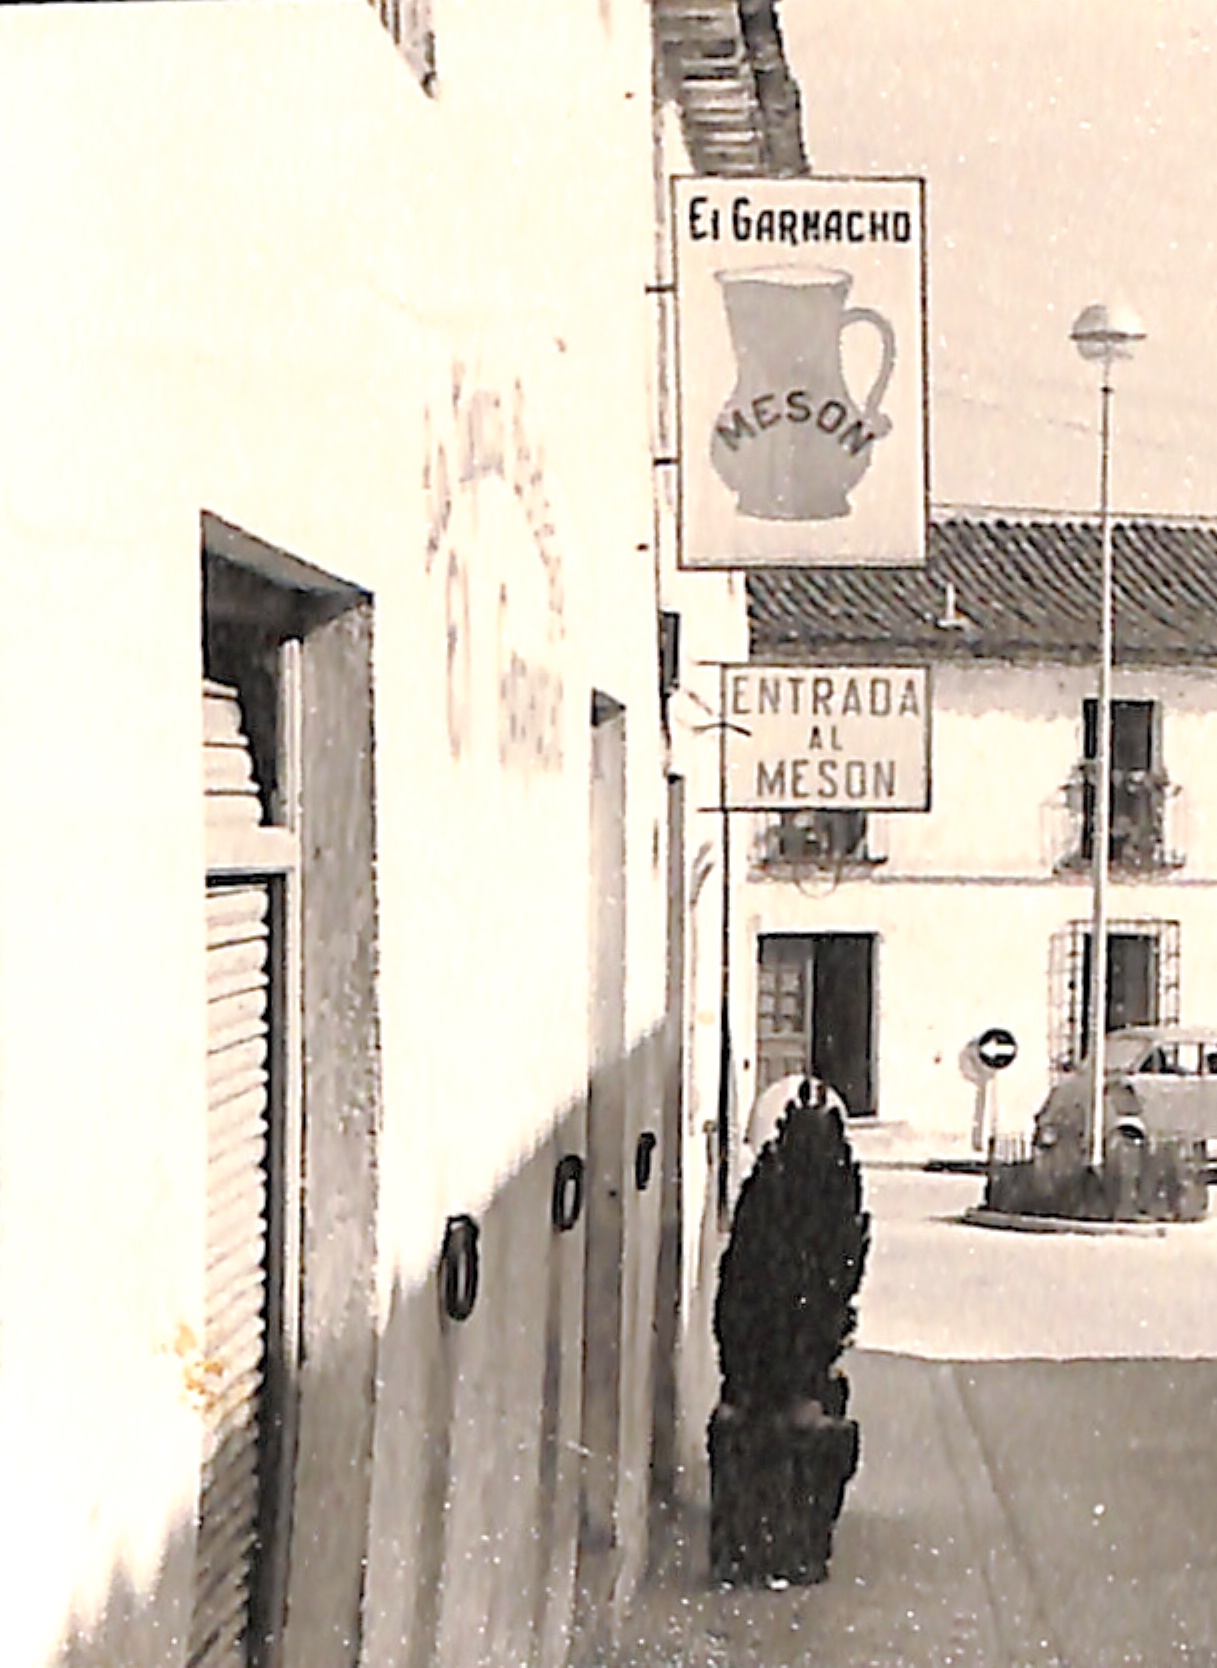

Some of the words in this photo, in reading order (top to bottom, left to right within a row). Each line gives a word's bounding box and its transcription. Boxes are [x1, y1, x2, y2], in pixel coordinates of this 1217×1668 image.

[716, 391, 876, 456] MESON
[733, 676, 919, 716] ENTRADA
[809, 726, 842, 750] AL
[757, 759, 895, 799] MESON
